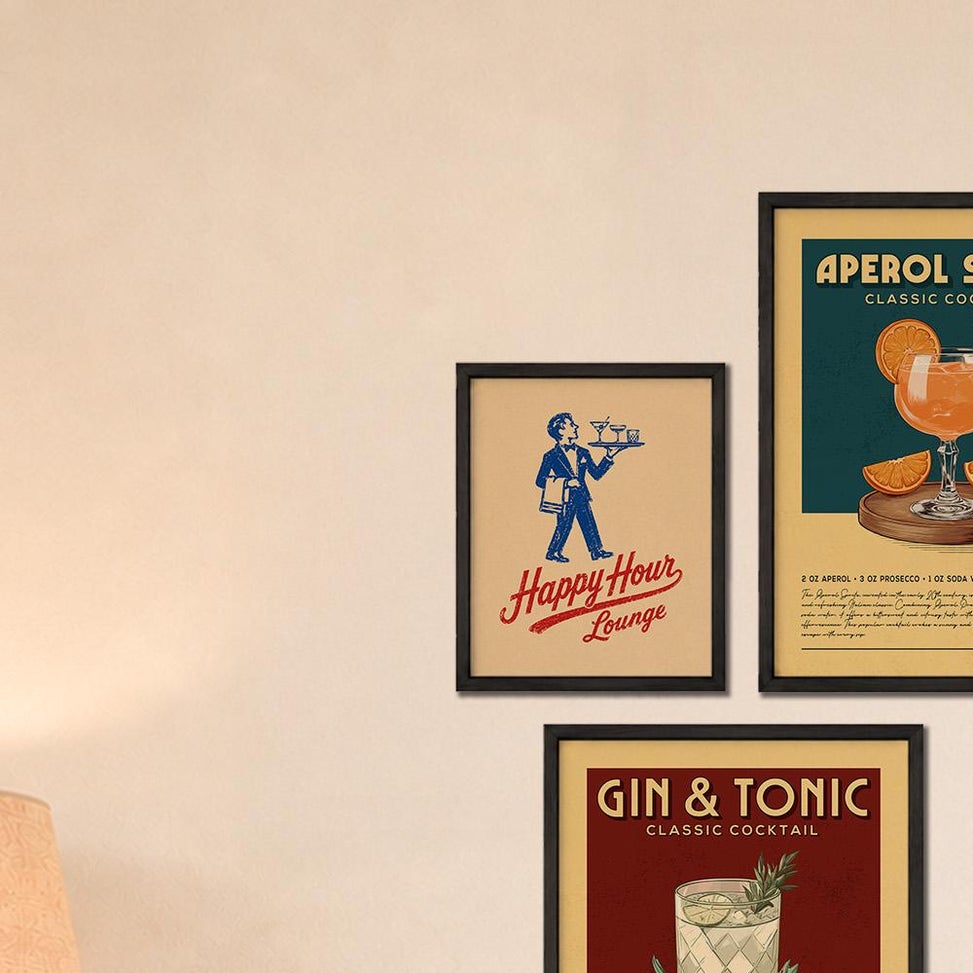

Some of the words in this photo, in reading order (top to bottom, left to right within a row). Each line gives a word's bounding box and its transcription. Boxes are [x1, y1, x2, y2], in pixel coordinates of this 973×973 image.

[815, 254, 950, 286] APEROL
[864, 293, 938, 305] CLASSIC
[499, 566, 605, 625] Happy
[605, 551, 683, 597] Hour
[801, 575, 807, 583] 2
[808, 575, 819, 583] OZ
[821, 575, 851, 583] APEROL
[859, 575, 865, 583] 3
[866, 575, 878, 583] OZ
[879, 575, 920, 583] PROSECCO
[933, 575, 944, 583] OZ
[946, 575, 968, 583] SODA
[582, 604, 667, 643] Lounge
[597, 777, 670, 818] GIN
[684, 777, 720, 818] &
[734, 777, 870, 818] TONIC
[646, 824, 723, 836] CLASSIC
[729, 824, 819, 836] COCKTAIL
